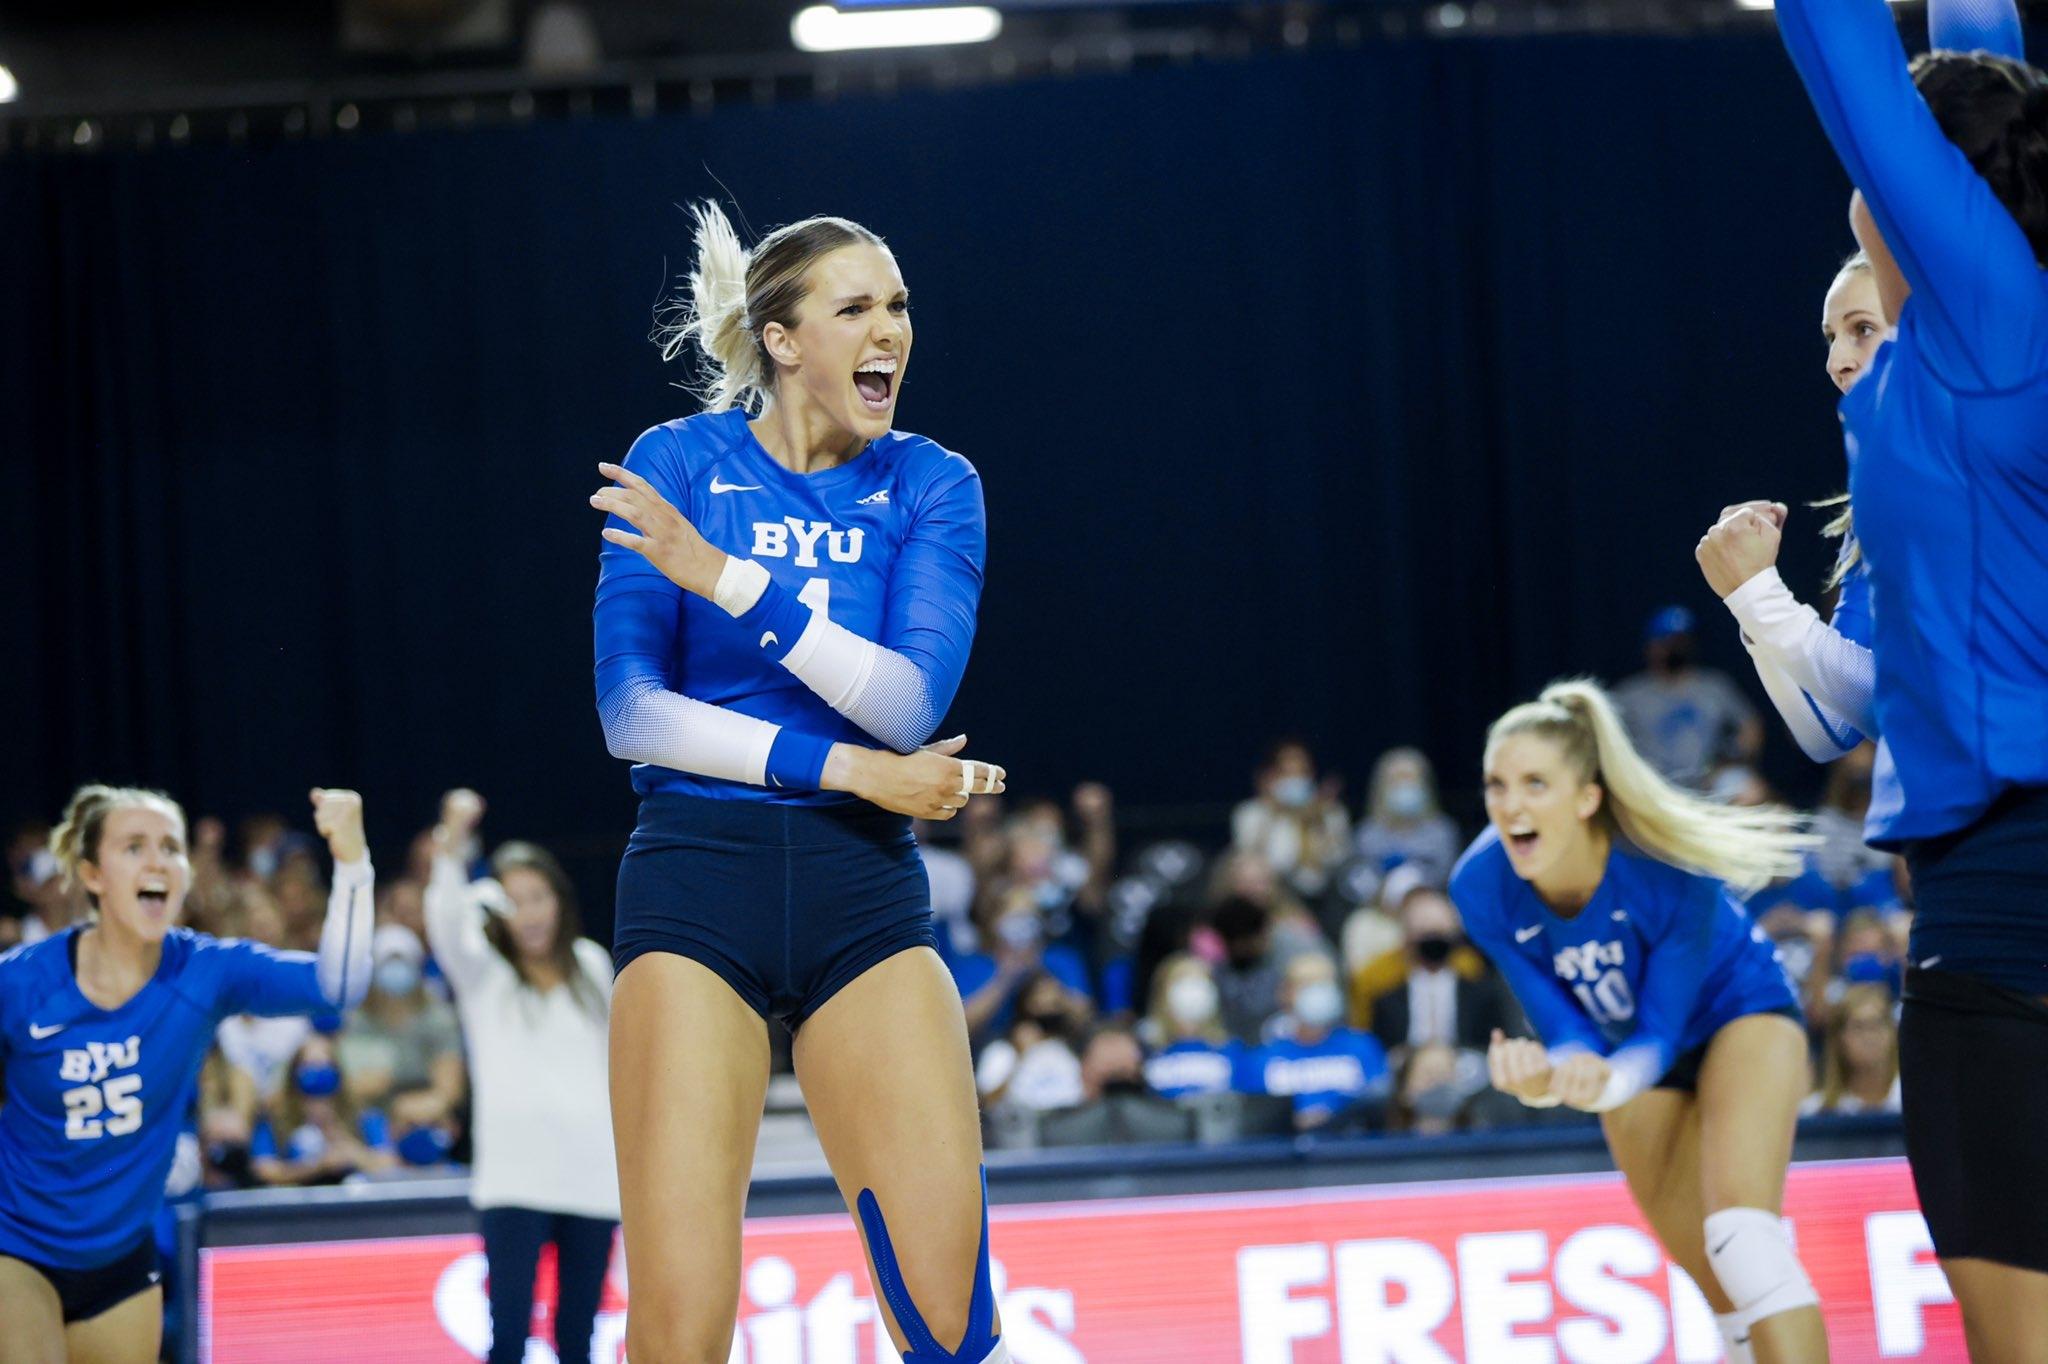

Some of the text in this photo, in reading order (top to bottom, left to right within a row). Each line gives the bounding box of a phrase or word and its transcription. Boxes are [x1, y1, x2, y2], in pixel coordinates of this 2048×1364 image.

[751, 515, 865, 568] BYU
[797, 577, 829, 622] 1
[1573, 968, 1634, 1026] 10
[59, 1035, 141, 1083] BYU
[63, 1073, 143, 1140] 25
